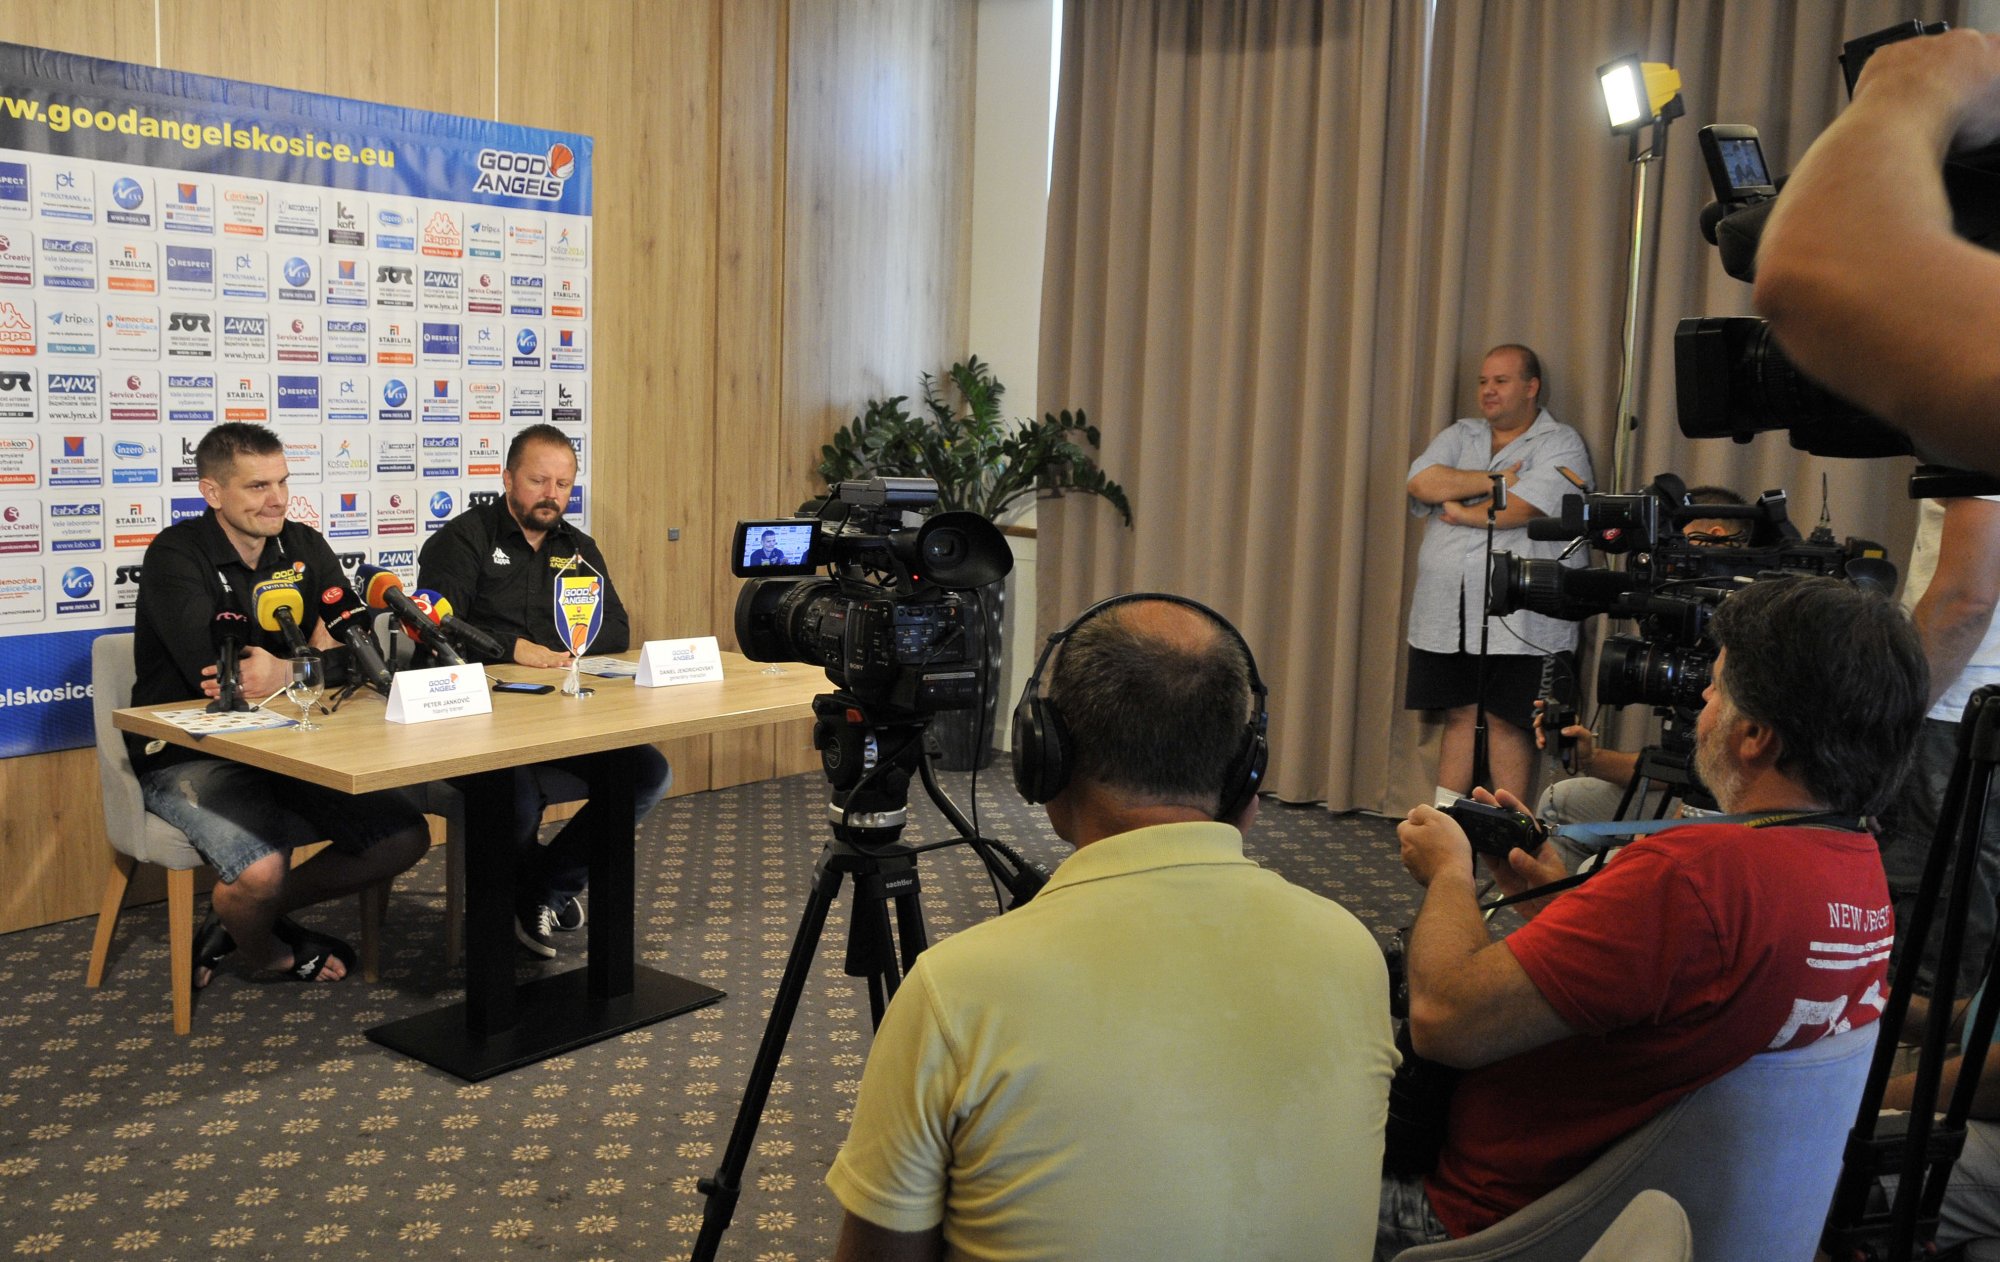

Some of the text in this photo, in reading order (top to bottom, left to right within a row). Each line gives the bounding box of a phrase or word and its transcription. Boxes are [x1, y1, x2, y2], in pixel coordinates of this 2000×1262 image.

[0, 96, 395, 168] w.goodangelskosice.eu
[479, 150, 547, 176] GOOD
[0, 177, 25, 185] PECT
[476, 176, 562, 199] ANGELS
[337, 220, 355, 230] koft
[424, 234, 460, 246] Kappa
[3, 253, 31, 263] Creativ
[109, 259, 152, 269] STABILITA
[178, 259, 211, 268] RESPECT
[376, 266, 413, 285] SOR
[425, 272, 458, 288] LYNX
[553, 291, 581, 299] STABILITA
[424, 302, 459, 311] www.lynx.sk
[65, 313, 94, 325] tripex
[115, 314, 155, 324] Nemocnica
[168, 312, 212, 333] SOR
[225, 318, 264, 334] LYNX
[0, 331, 32, 342] ppa
[277, 334, 319, 342] Service Creativ
[431, 335, 458, 343] RESPECT
[0, 345, 31, 354] appa.sk
[55, 344, 87, 353] tripex.sk
[224, 351, 265, 360] www.lynx.sk
[0, 371, 32, 392] OR
[49, 375, 95, 392] LYNX
[135, 391, 158, 399] Creativ
[227, 391, 264, 399] STABILITA
[287, 388, 317, 396] RESPECT
[558, 400, 573, 408] koft
[48, 411, 97, 422] www.lynx.sk
[0, 440, 27, 448] takon
[328, 459, 368, 469] Košice 2016
[181, 510, 204, 518] RESPE
[116, 516, 156, 525] STABILITA
[13, 523, 39, 531] Creativ
[56, 540, 96, 550] www.labo.sk
[380, 552, 413, 565] LYNX
[114, 565, 140, 584] SO
[0, 577, 37, 585] emocnica
[564, 588, 590, 597] GOOD
[562, 596, 595, 605] ANGELS
[60, 602, 97, 611] www.ness.sk
[849, 662, 864, 671] SONY
[428, 679, 450, 687] GOOD
[429, 685, 456, 693] ANGELS
[885, 879, 913, 889] sachtler
[1827, 902, 1863, 932] NEW
